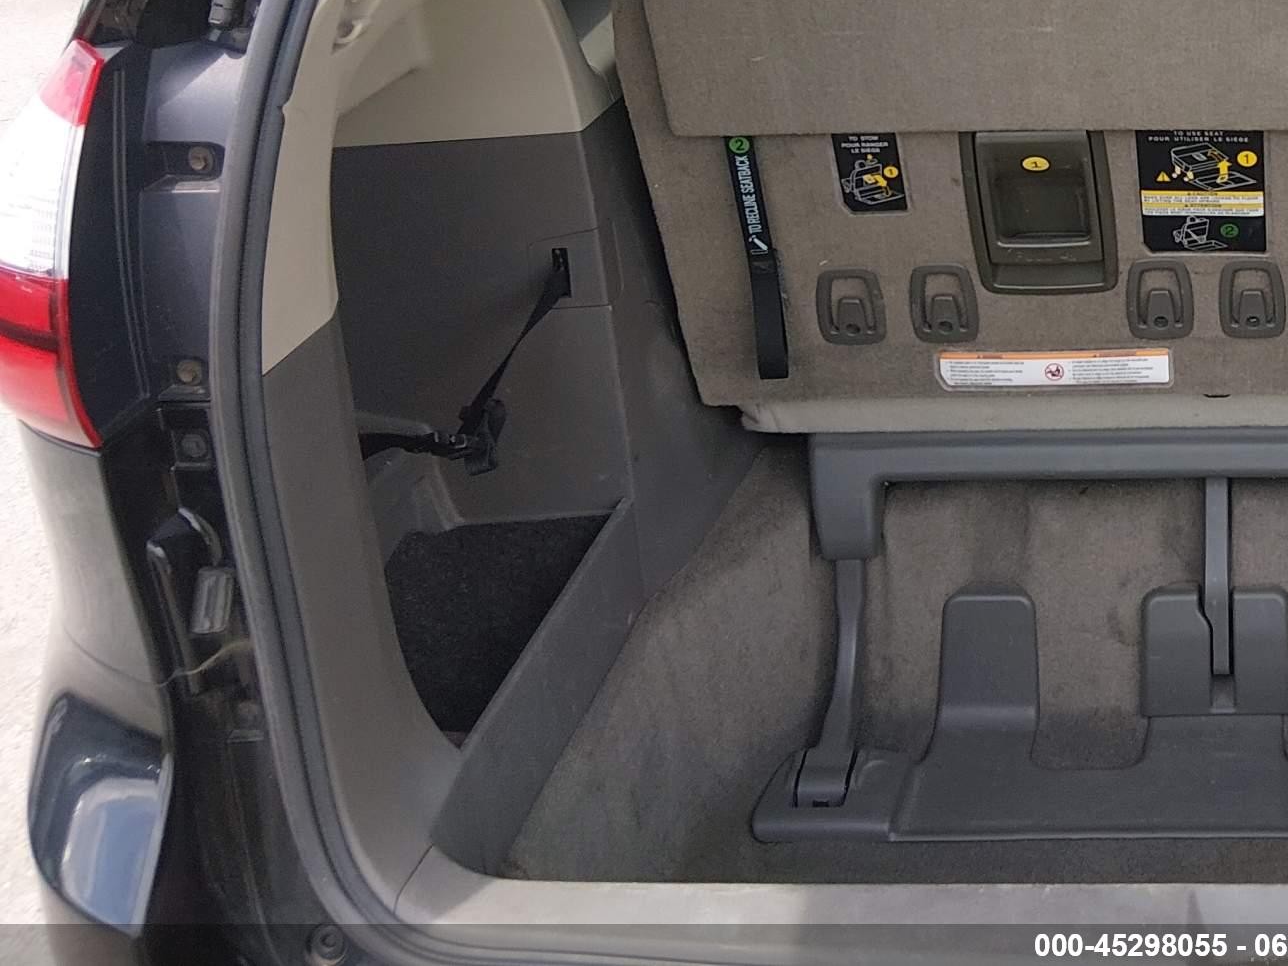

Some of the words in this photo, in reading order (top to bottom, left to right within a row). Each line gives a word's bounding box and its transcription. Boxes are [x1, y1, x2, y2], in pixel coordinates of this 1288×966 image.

[735, 155, 755, 193] SEATBACK
[742, 194, 761, 224] RECLINE
[748, 224, 763, 234] TO
